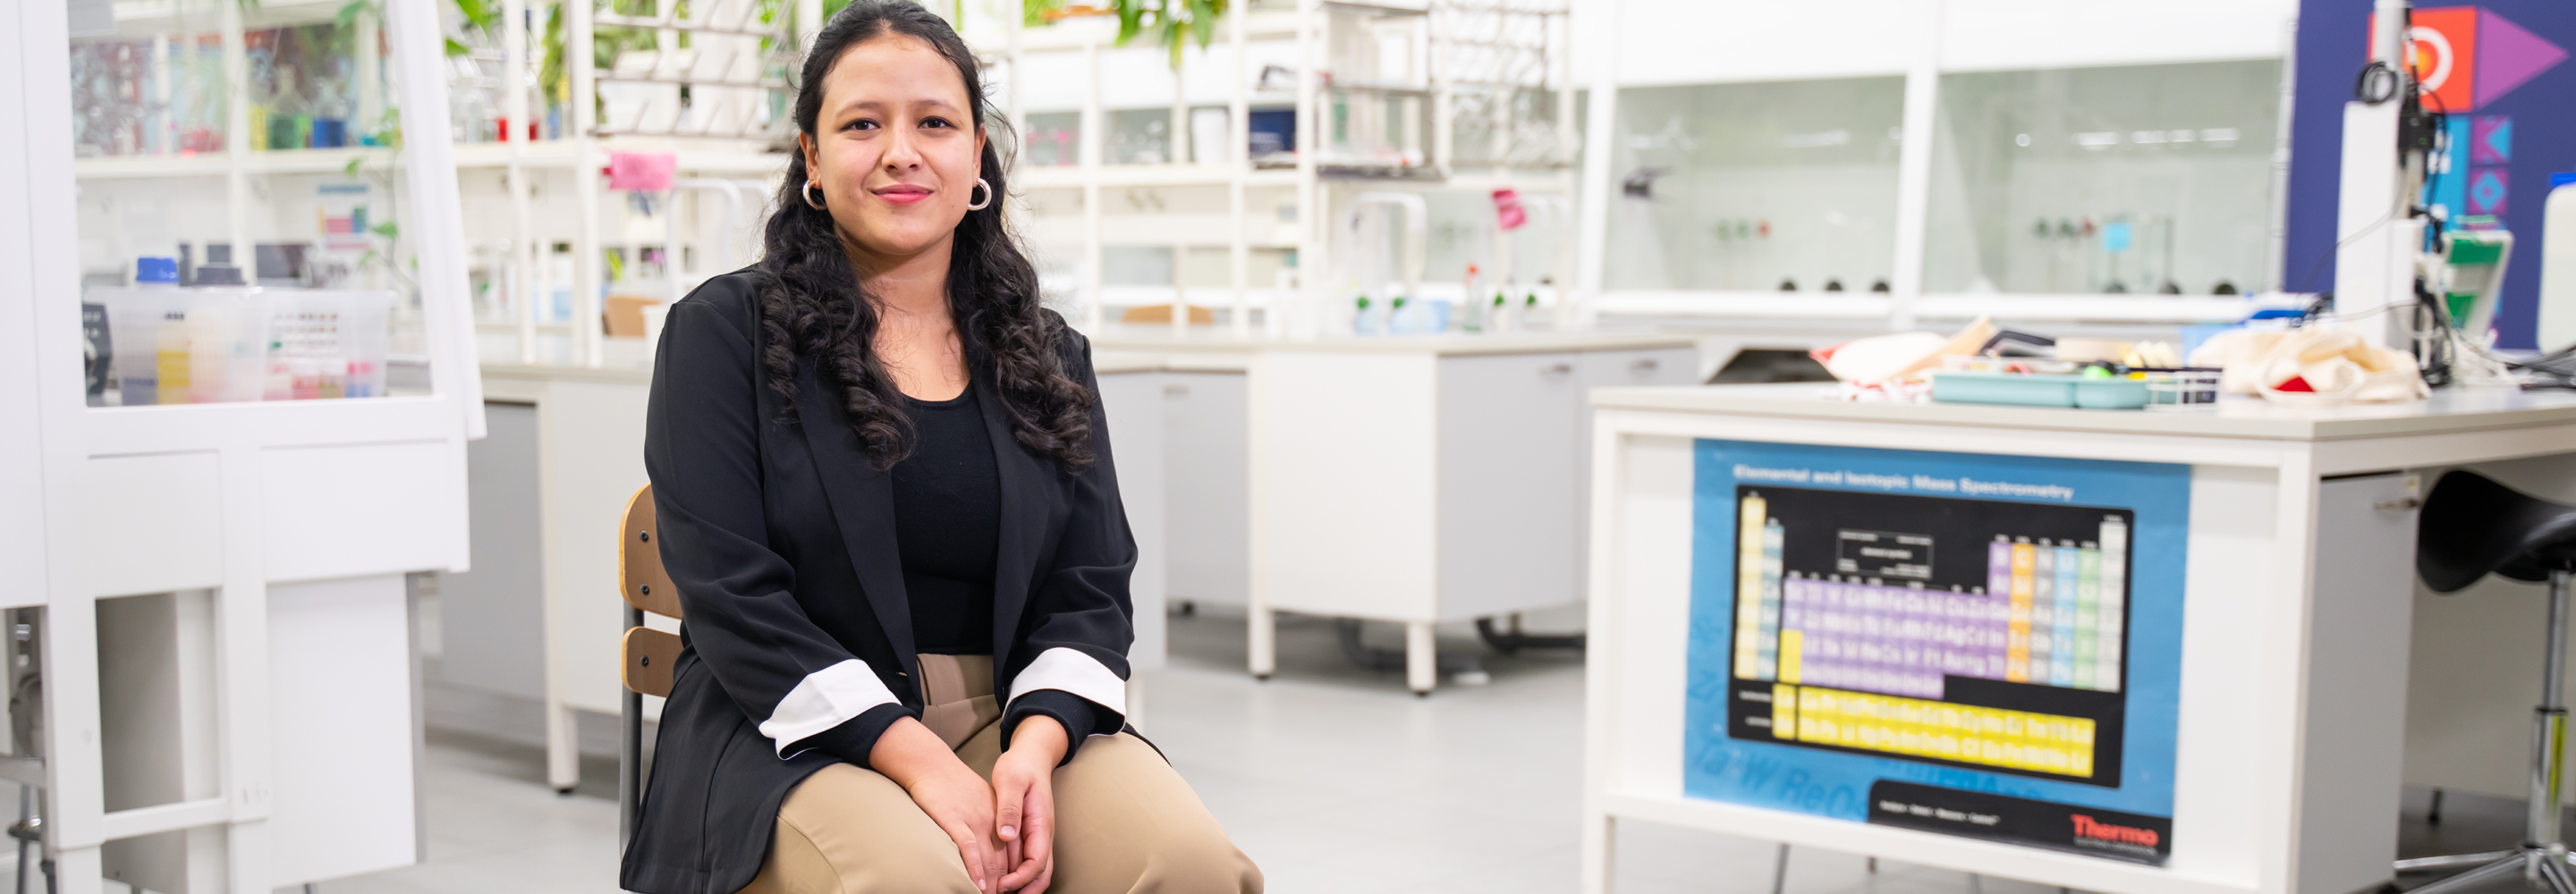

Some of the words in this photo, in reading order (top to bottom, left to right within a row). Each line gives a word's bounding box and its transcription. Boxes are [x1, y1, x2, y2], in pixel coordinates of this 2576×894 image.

[1733, 464, 1809, 482] Elemental
[1812, 470, 1843, 485] and
[1845, 470, 1910, 490] Isotopic
[1912, 475, 1956, 492] Mass
[1959, 477, 2074, 502] Spectrometry
[2070, 814, 2159, 847] Thermo
